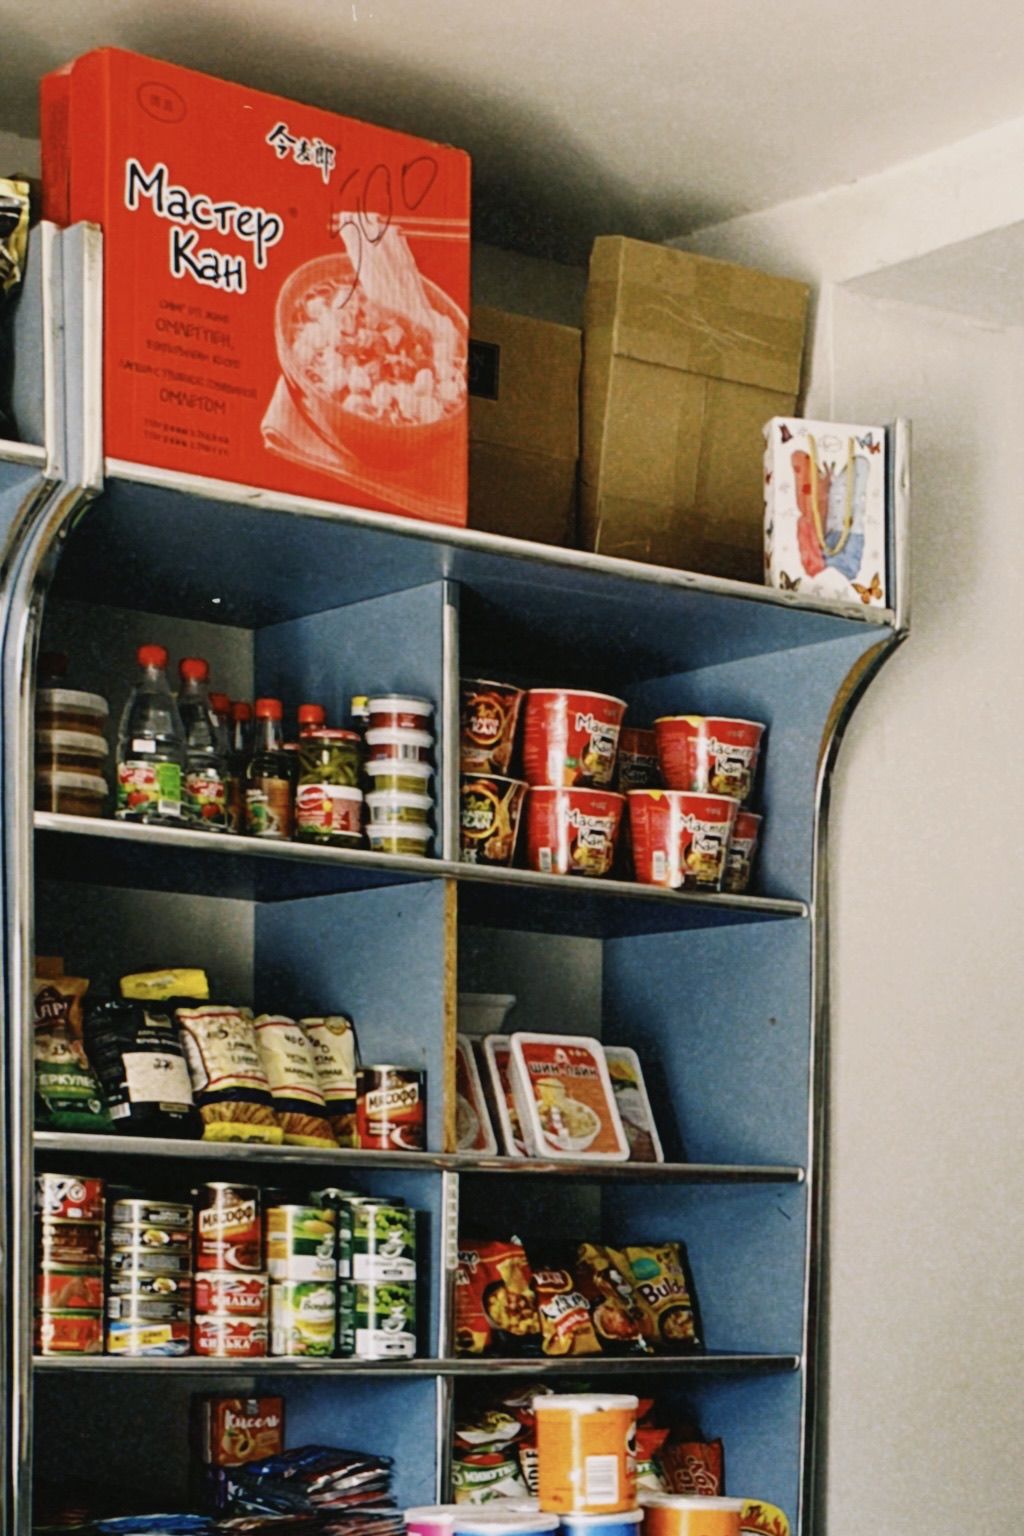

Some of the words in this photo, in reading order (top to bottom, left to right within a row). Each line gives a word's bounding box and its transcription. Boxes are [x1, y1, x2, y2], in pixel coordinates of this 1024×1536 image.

[127, 162, 281, 266] Мастер
[173, 229, 245, 290] Кан
[225, 1410, 281, 1430] Кисель
